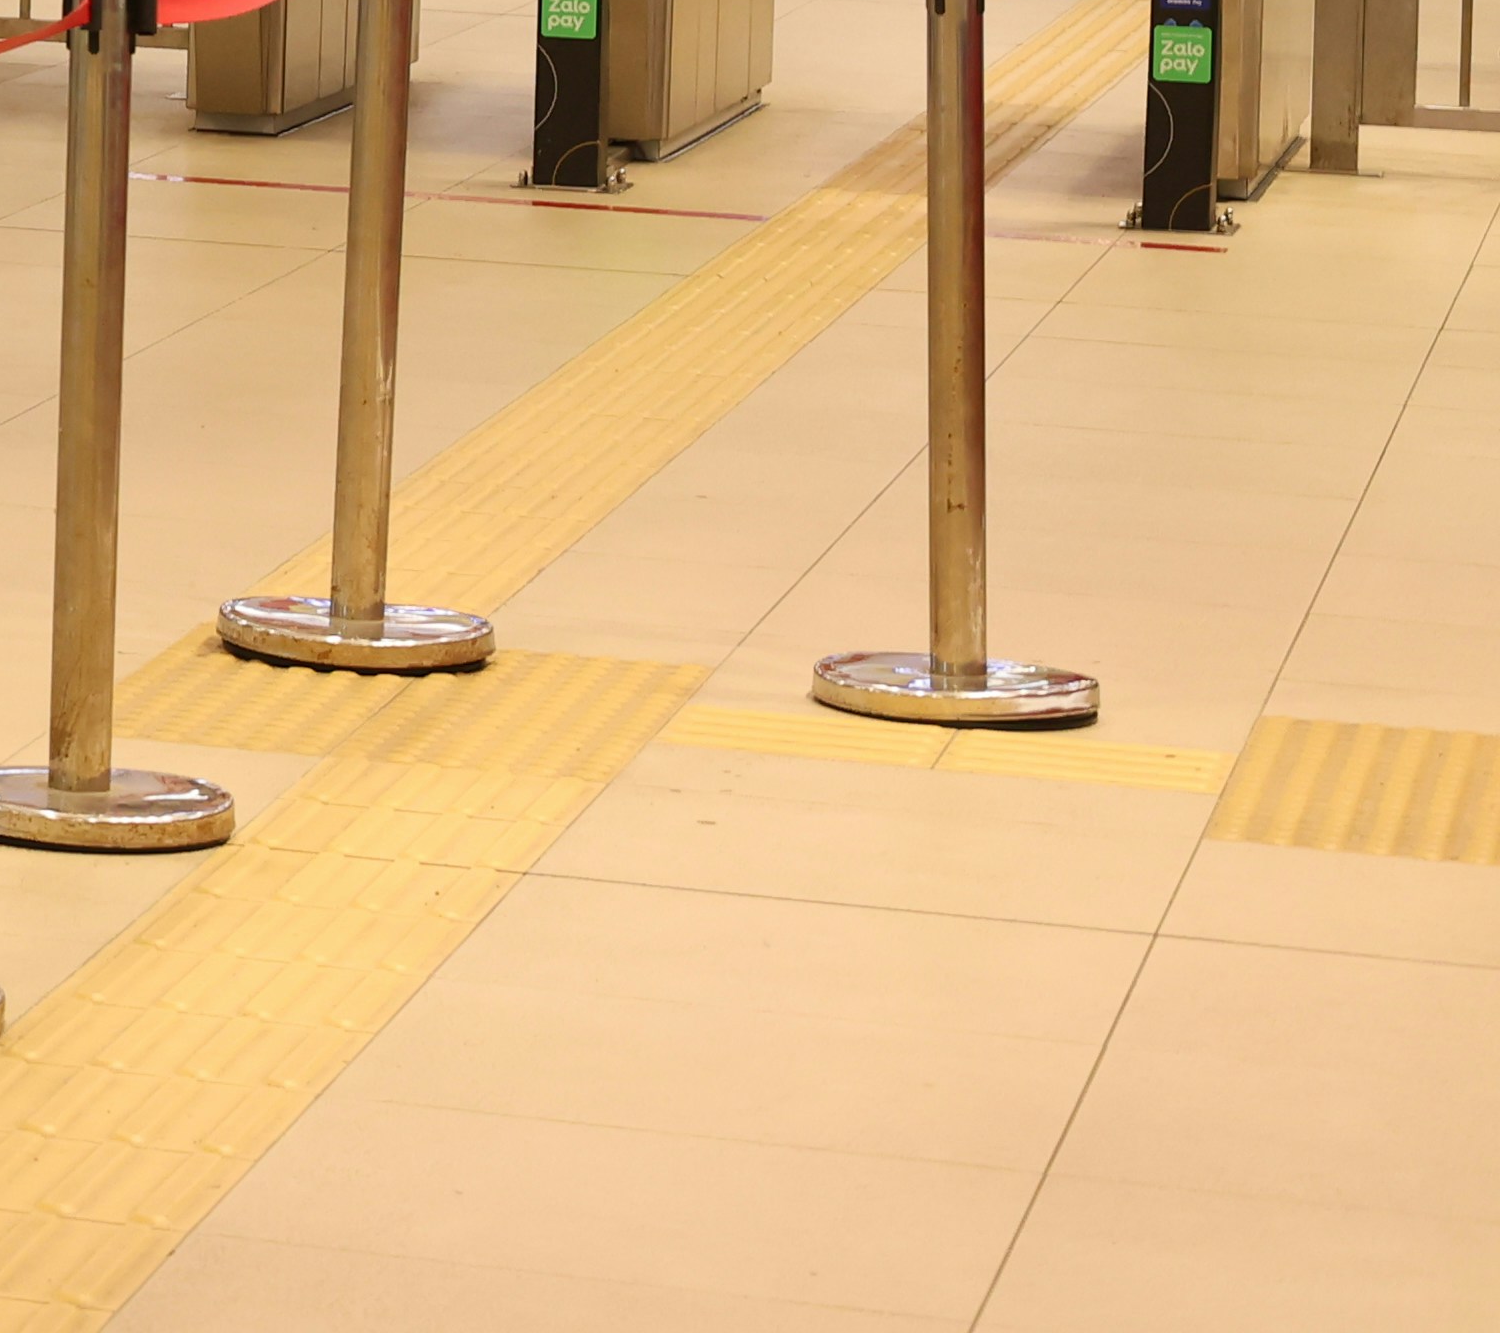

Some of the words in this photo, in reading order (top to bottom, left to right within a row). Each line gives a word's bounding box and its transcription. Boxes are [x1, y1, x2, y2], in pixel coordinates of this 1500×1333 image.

[547, 14, 585, 31] pay
[1161, 39, 1205, 57] Zalo
[1160, 58, 1198, 75] pay
